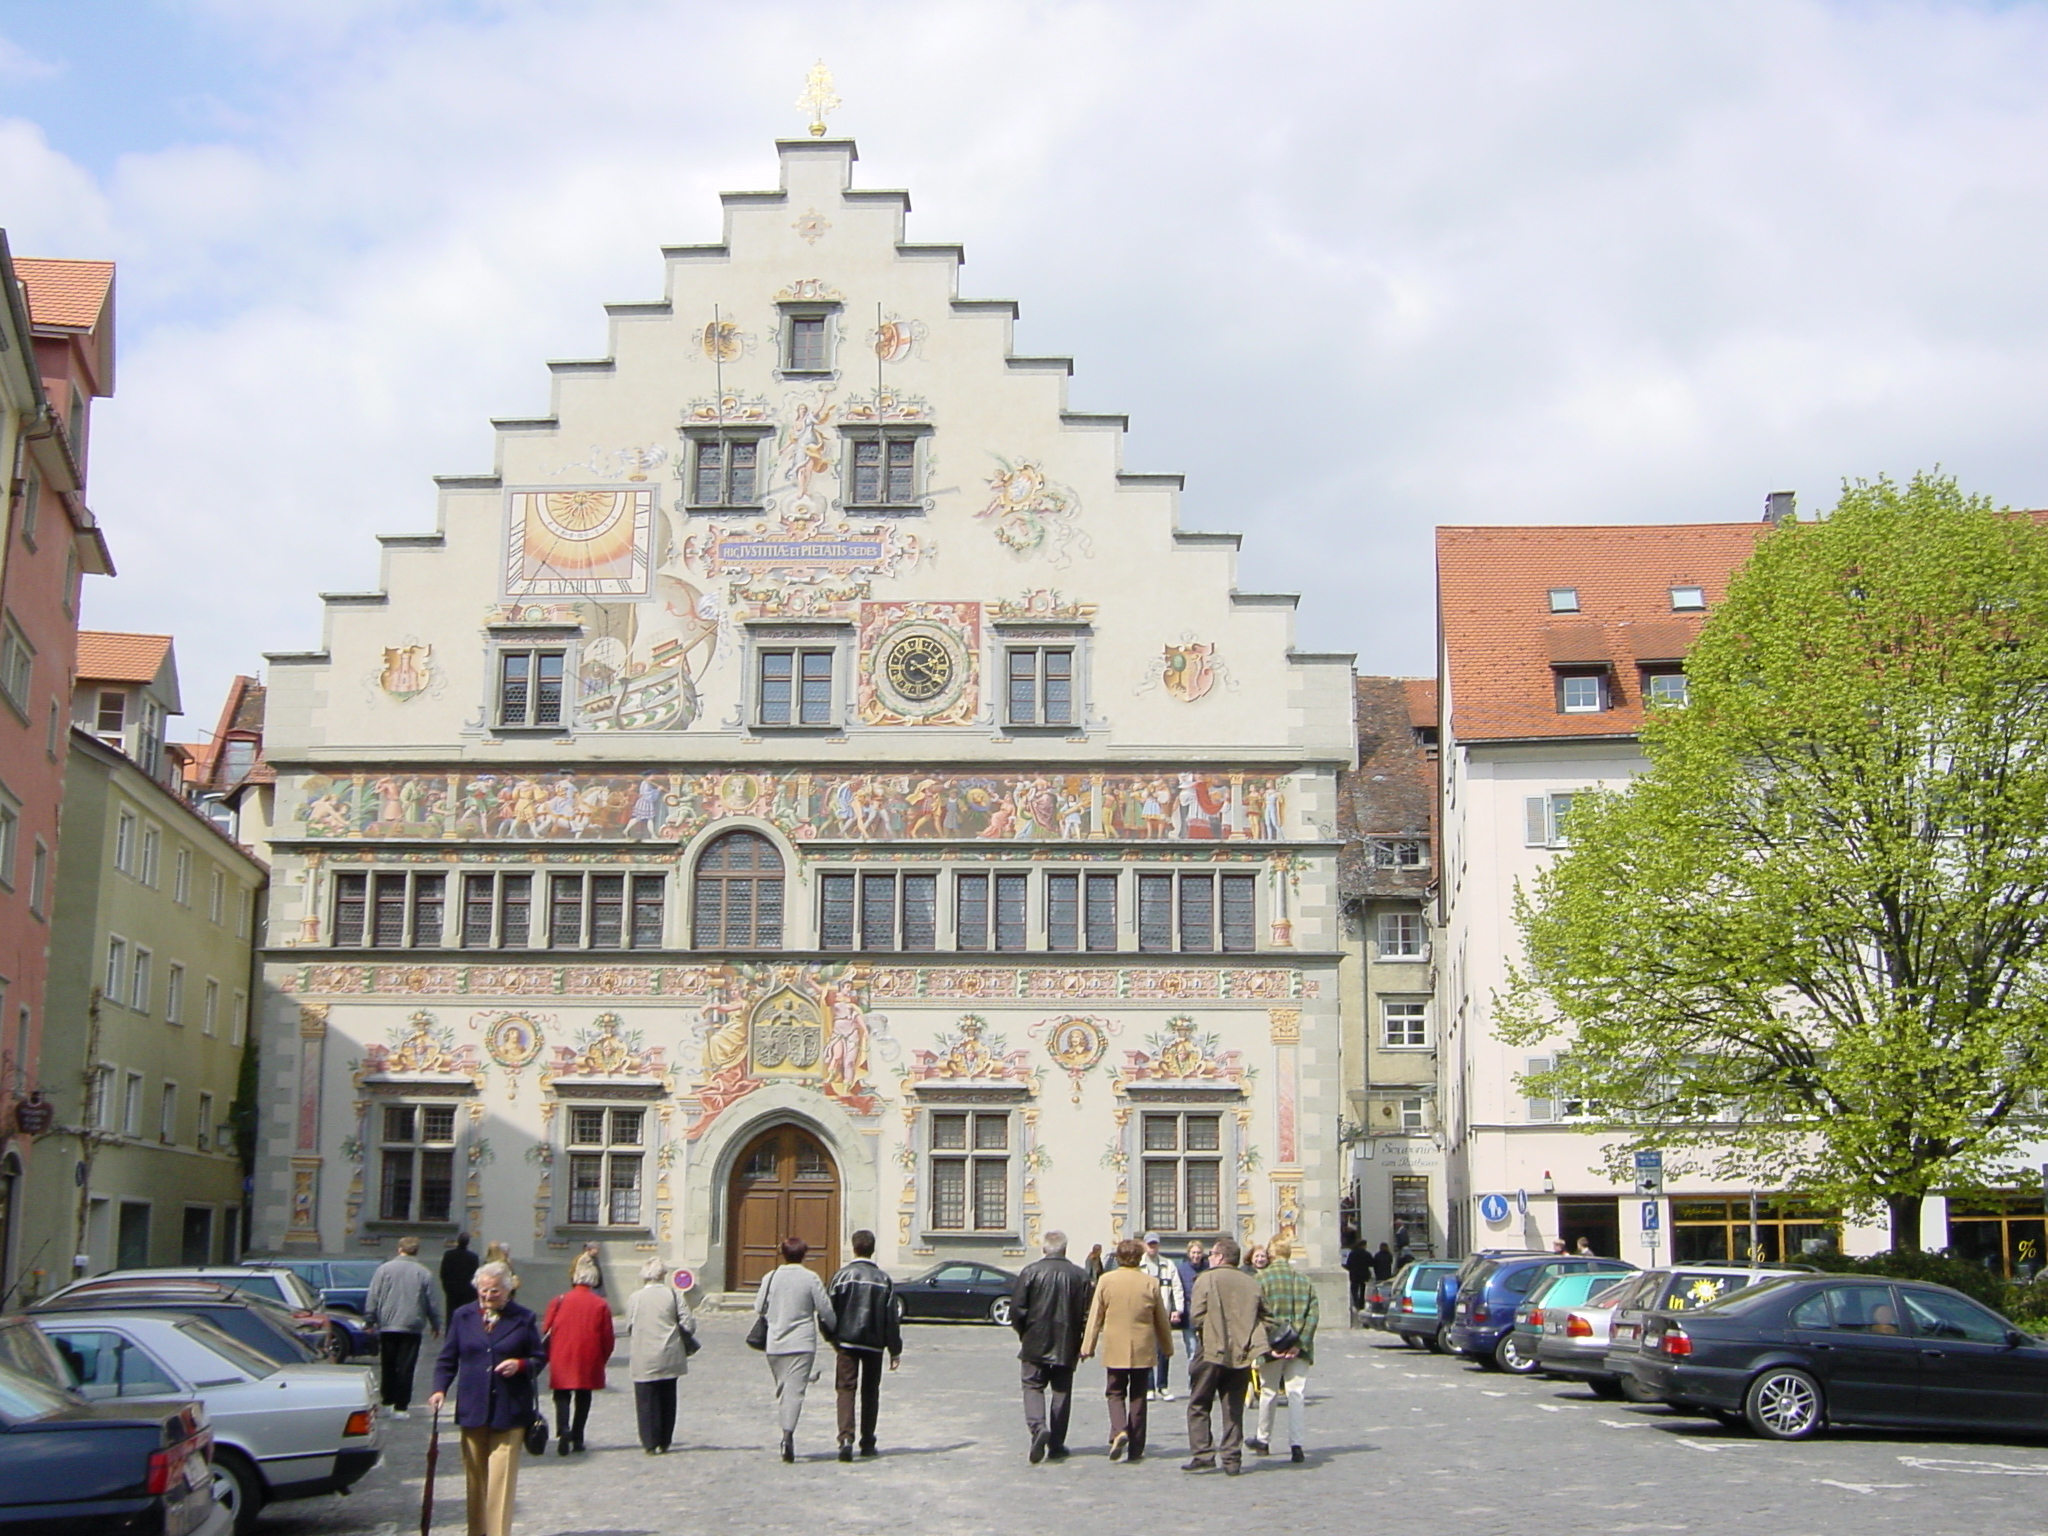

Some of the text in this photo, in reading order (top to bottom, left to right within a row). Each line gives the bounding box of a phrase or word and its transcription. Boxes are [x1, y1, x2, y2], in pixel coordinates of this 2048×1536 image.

[801, 544, 847, 557] PIETATIS
[848, 546, 878, 557] SEDES
[1645, 1204, 1655, 1227] P
